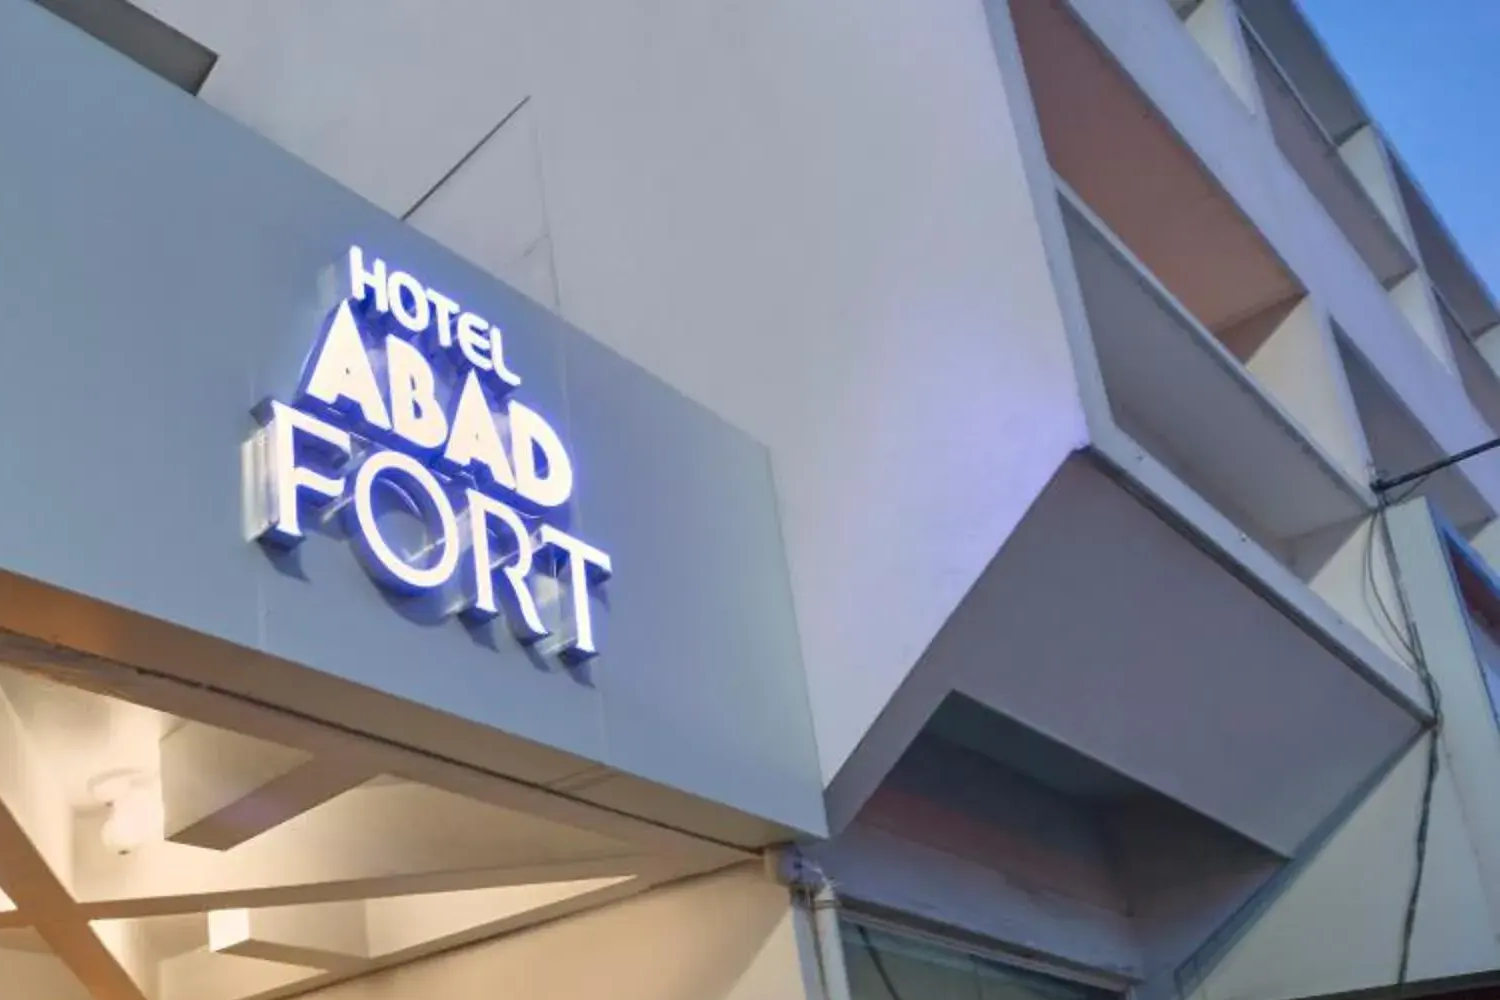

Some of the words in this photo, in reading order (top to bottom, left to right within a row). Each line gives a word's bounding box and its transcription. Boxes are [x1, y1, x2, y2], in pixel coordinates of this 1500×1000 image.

[306, 298, 573, 507] ABAD
[349, 245, 521, 386] HOTEL
[271, 400, 612, 653] FORT
